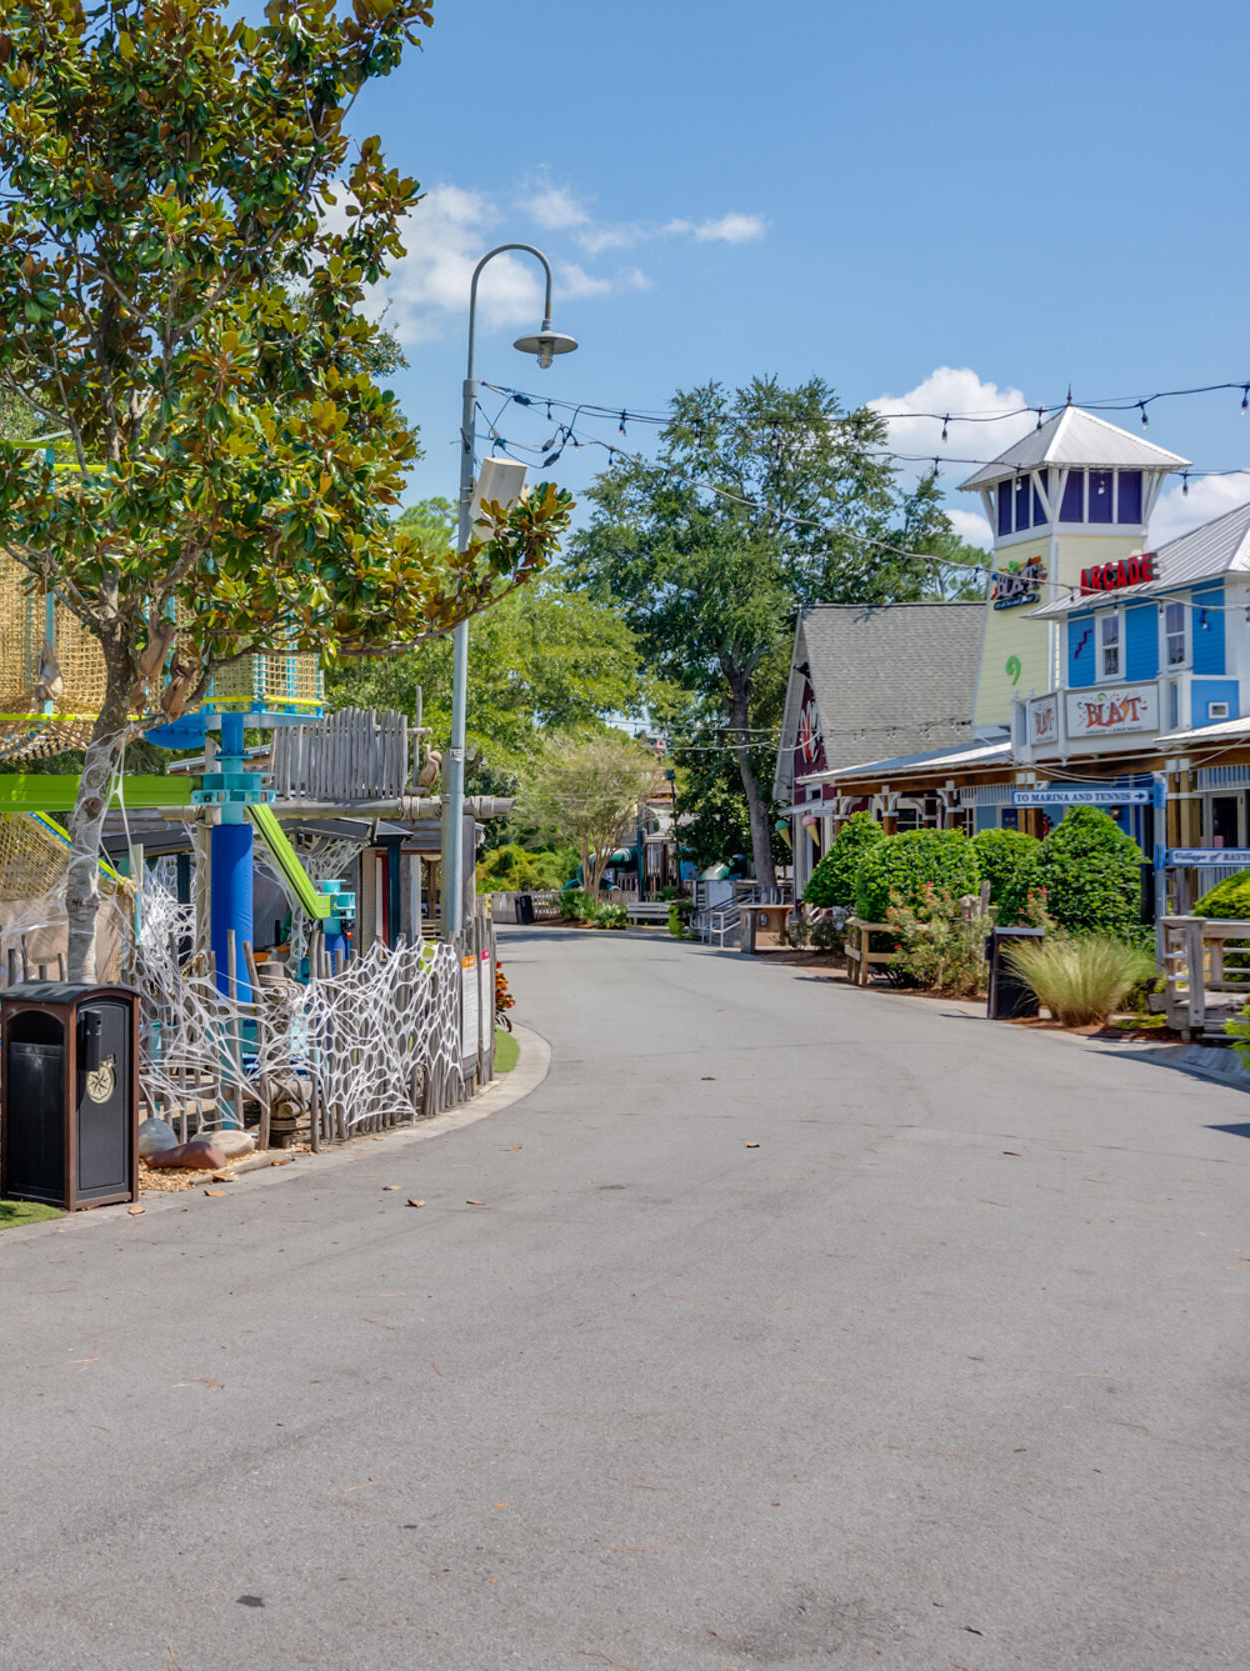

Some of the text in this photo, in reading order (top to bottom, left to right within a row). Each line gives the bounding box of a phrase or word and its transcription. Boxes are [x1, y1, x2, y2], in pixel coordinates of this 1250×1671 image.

[1080, 552, 1153, 597] ARCADE
[1085, 696, 1141, 728] BLAST
[1016, 791, 1132, 802] TO MARINA AND TENNIS
